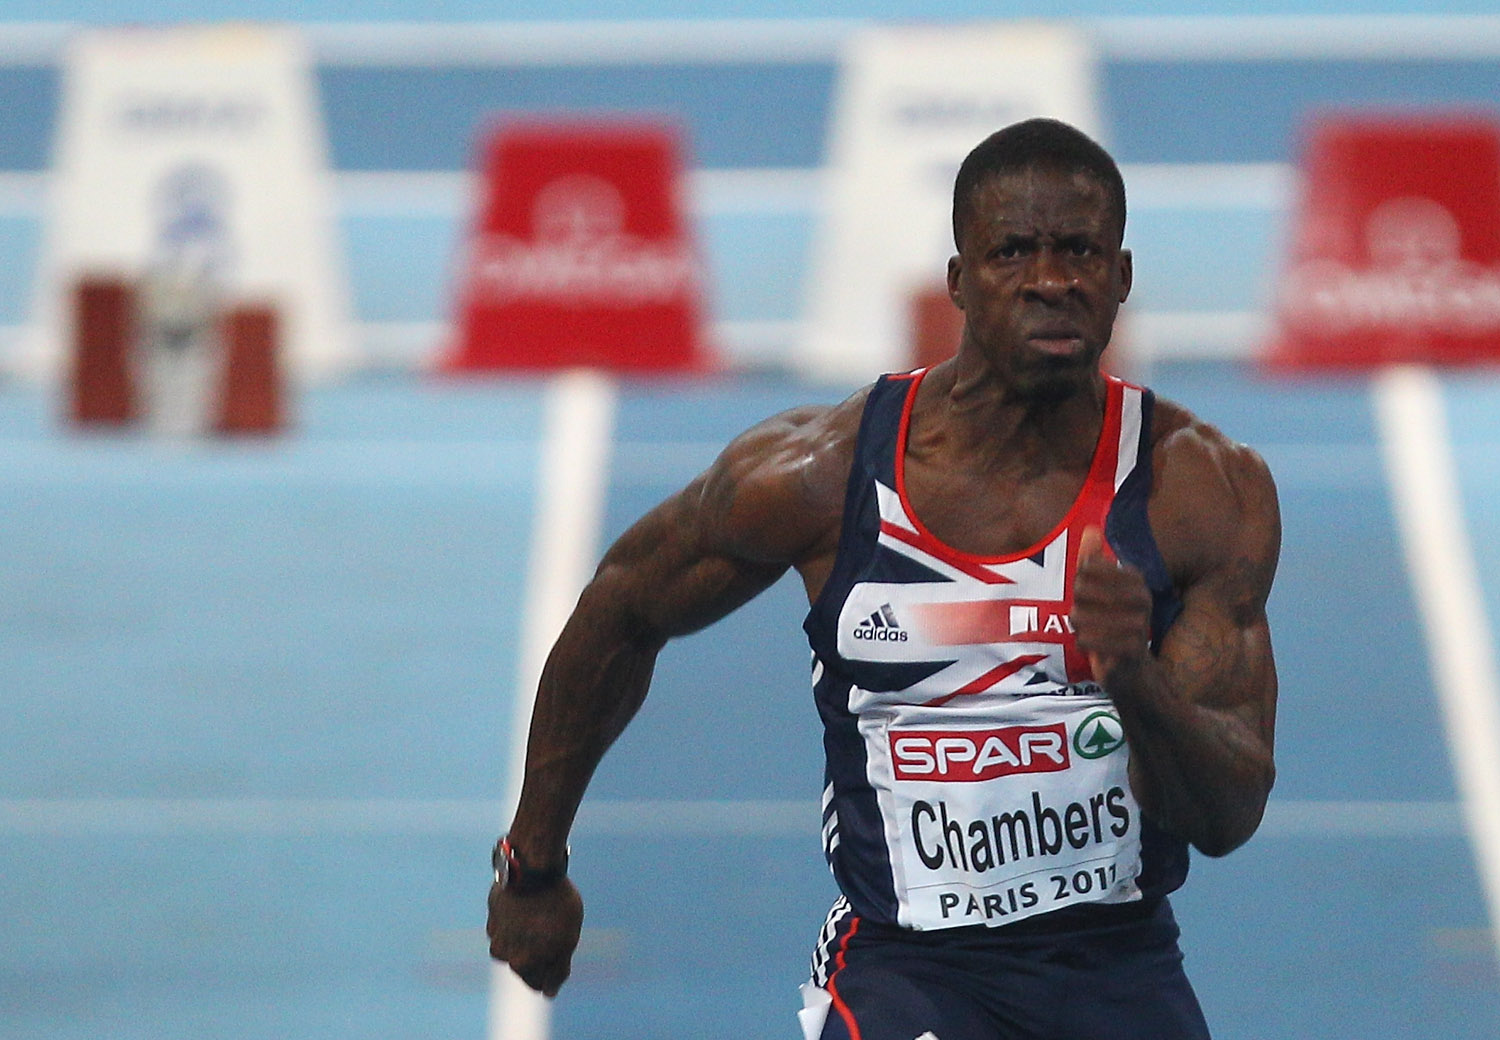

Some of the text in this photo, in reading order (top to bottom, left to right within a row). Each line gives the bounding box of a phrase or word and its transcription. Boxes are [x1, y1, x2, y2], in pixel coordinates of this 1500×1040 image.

[853, 626, 908, 642] adidas
[894, 731, 1065, 776] SPAR
[911, 786, 1131, 874] Chambers
[939, 863, 1118, 919] PARIS 2011
